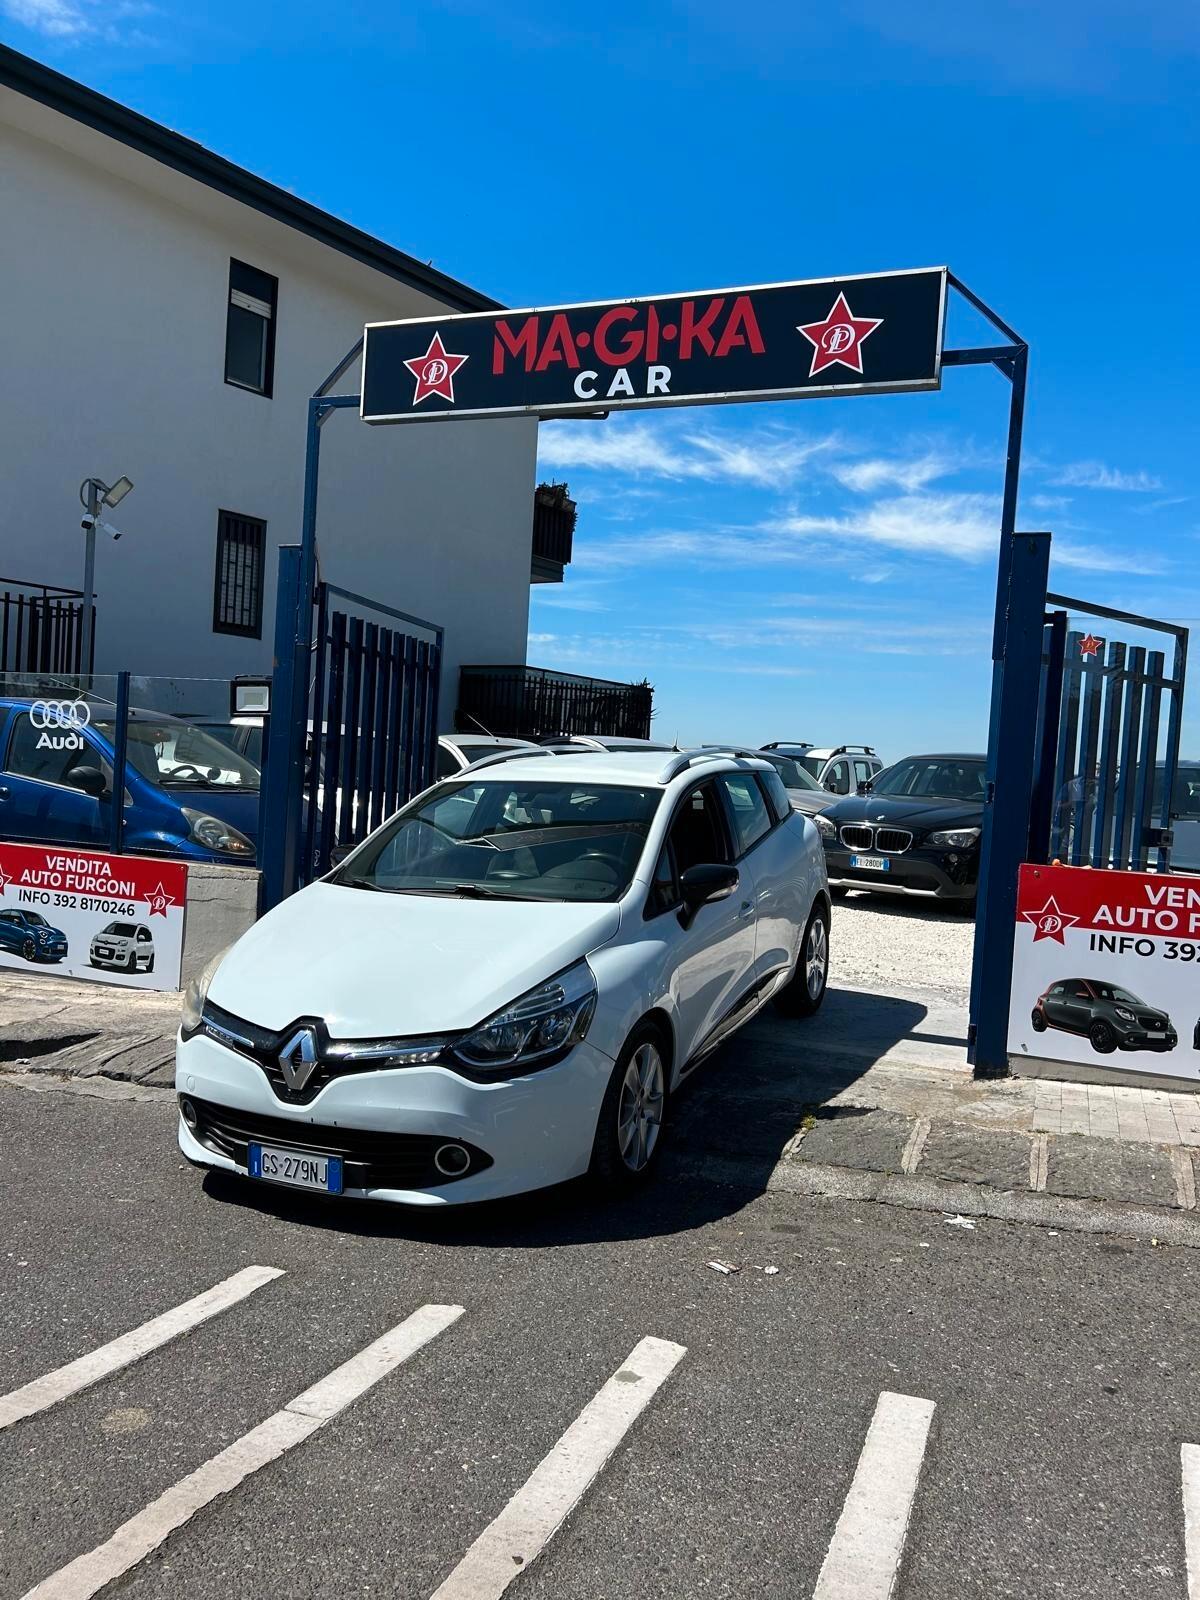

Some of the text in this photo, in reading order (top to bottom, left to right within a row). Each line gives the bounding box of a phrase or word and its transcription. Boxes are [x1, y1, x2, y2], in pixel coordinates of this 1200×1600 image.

[573, 365, 672, 399] CAR
[35, 732, 84, 750] Audi
[46, 854, 112, 877] VENDITA
[20, 868, 62, 887] AUTO
[65, 874, 136, 897] FURGONI
[18, 889, 135, 916] INFO 392 8170246
[1092, 904, 1179, 931] AUTO
[1089, 933, 1156, 957] INFO
